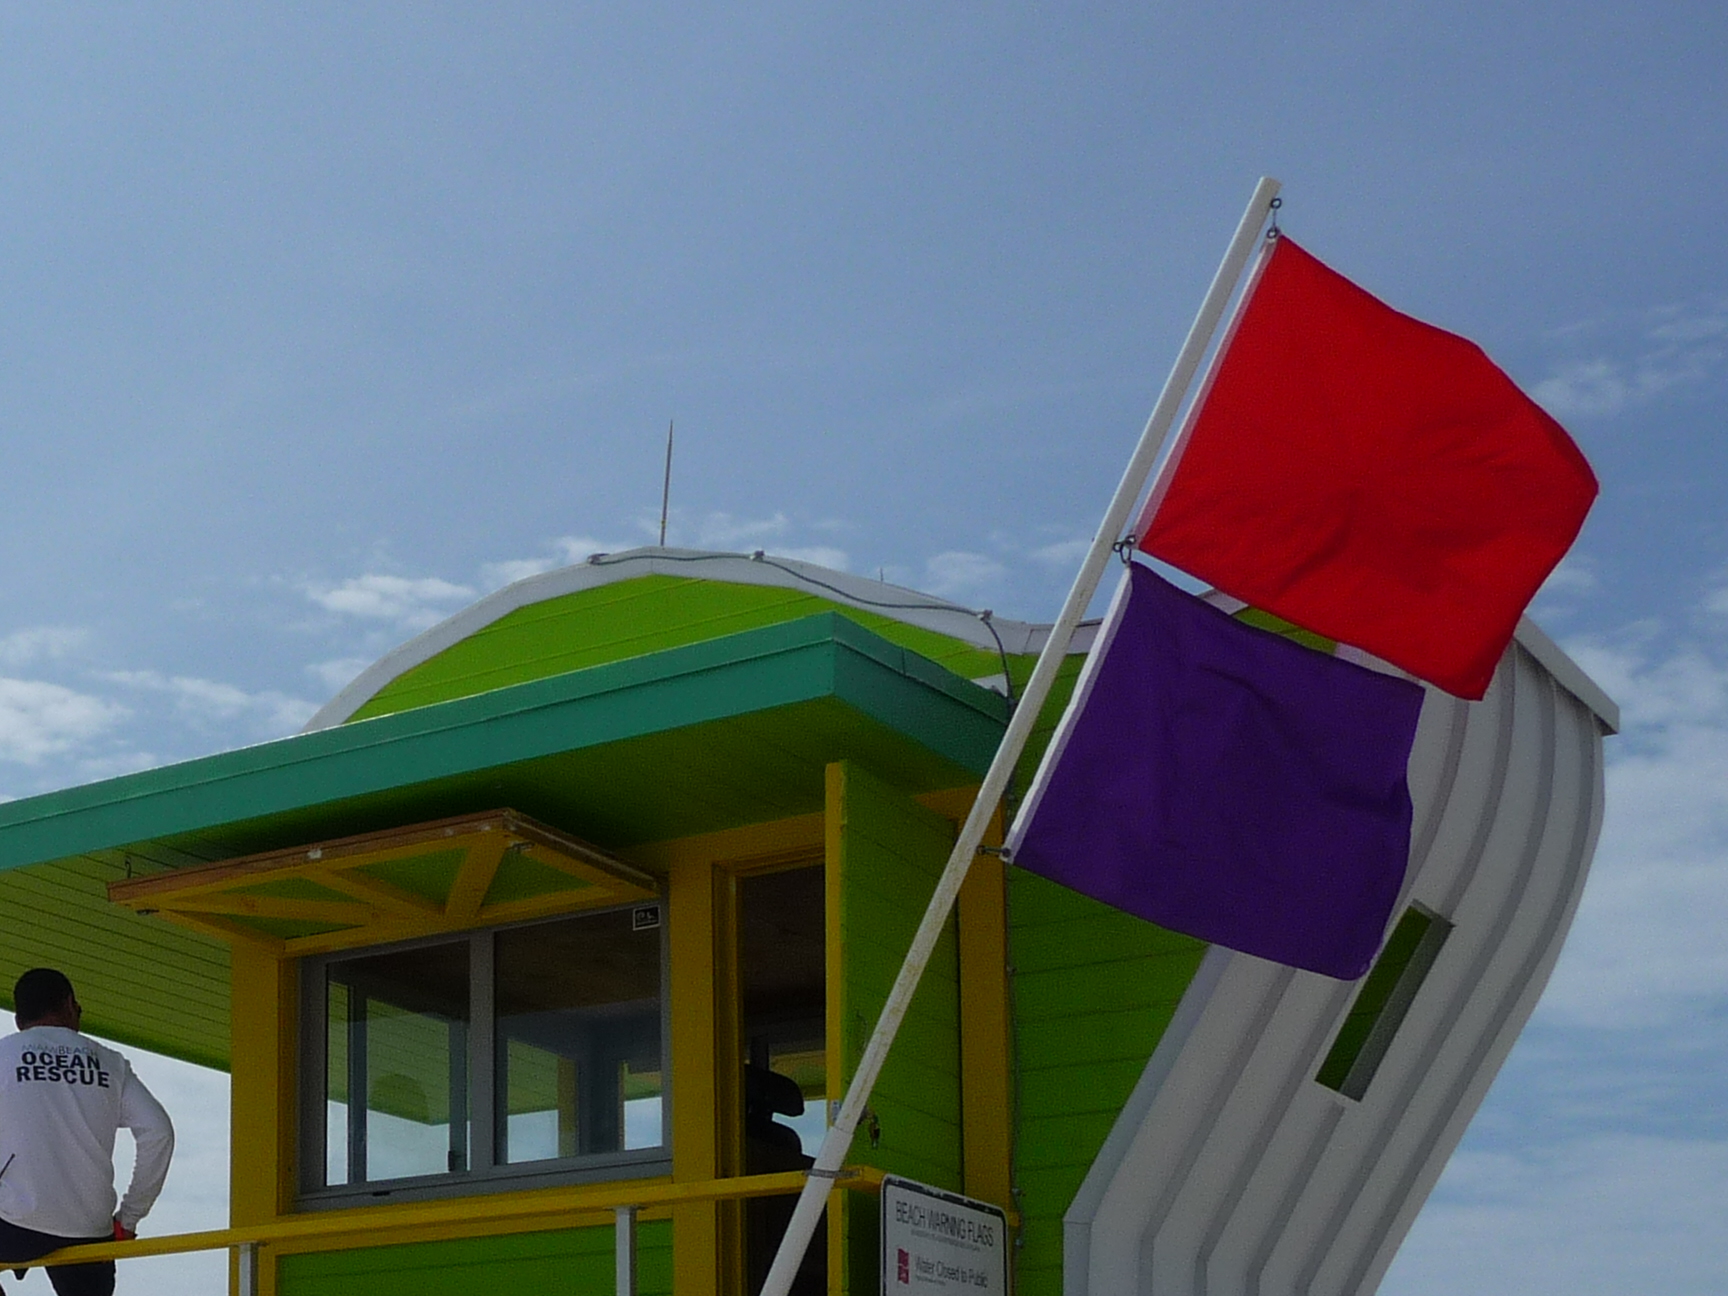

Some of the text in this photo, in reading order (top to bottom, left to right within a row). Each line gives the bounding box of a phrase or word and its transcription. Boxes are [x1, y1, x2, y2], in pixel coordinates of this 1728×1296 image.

[21, 1051, 101, 1071] OCEAN
[16, 1066, 110, 1089] RESCUE
[896, 1200, 926, 1229] BEACH
[928, 1209, 966, 1239] WARNING
[967, 1221, 994, 1247] FLAGS
[915, 1256, 935, 1275] Water
[936, 1261, 960, 1281] Closed
[960, 1267, 968, 1283] to
[968, 1269, 989, 1288] Public
